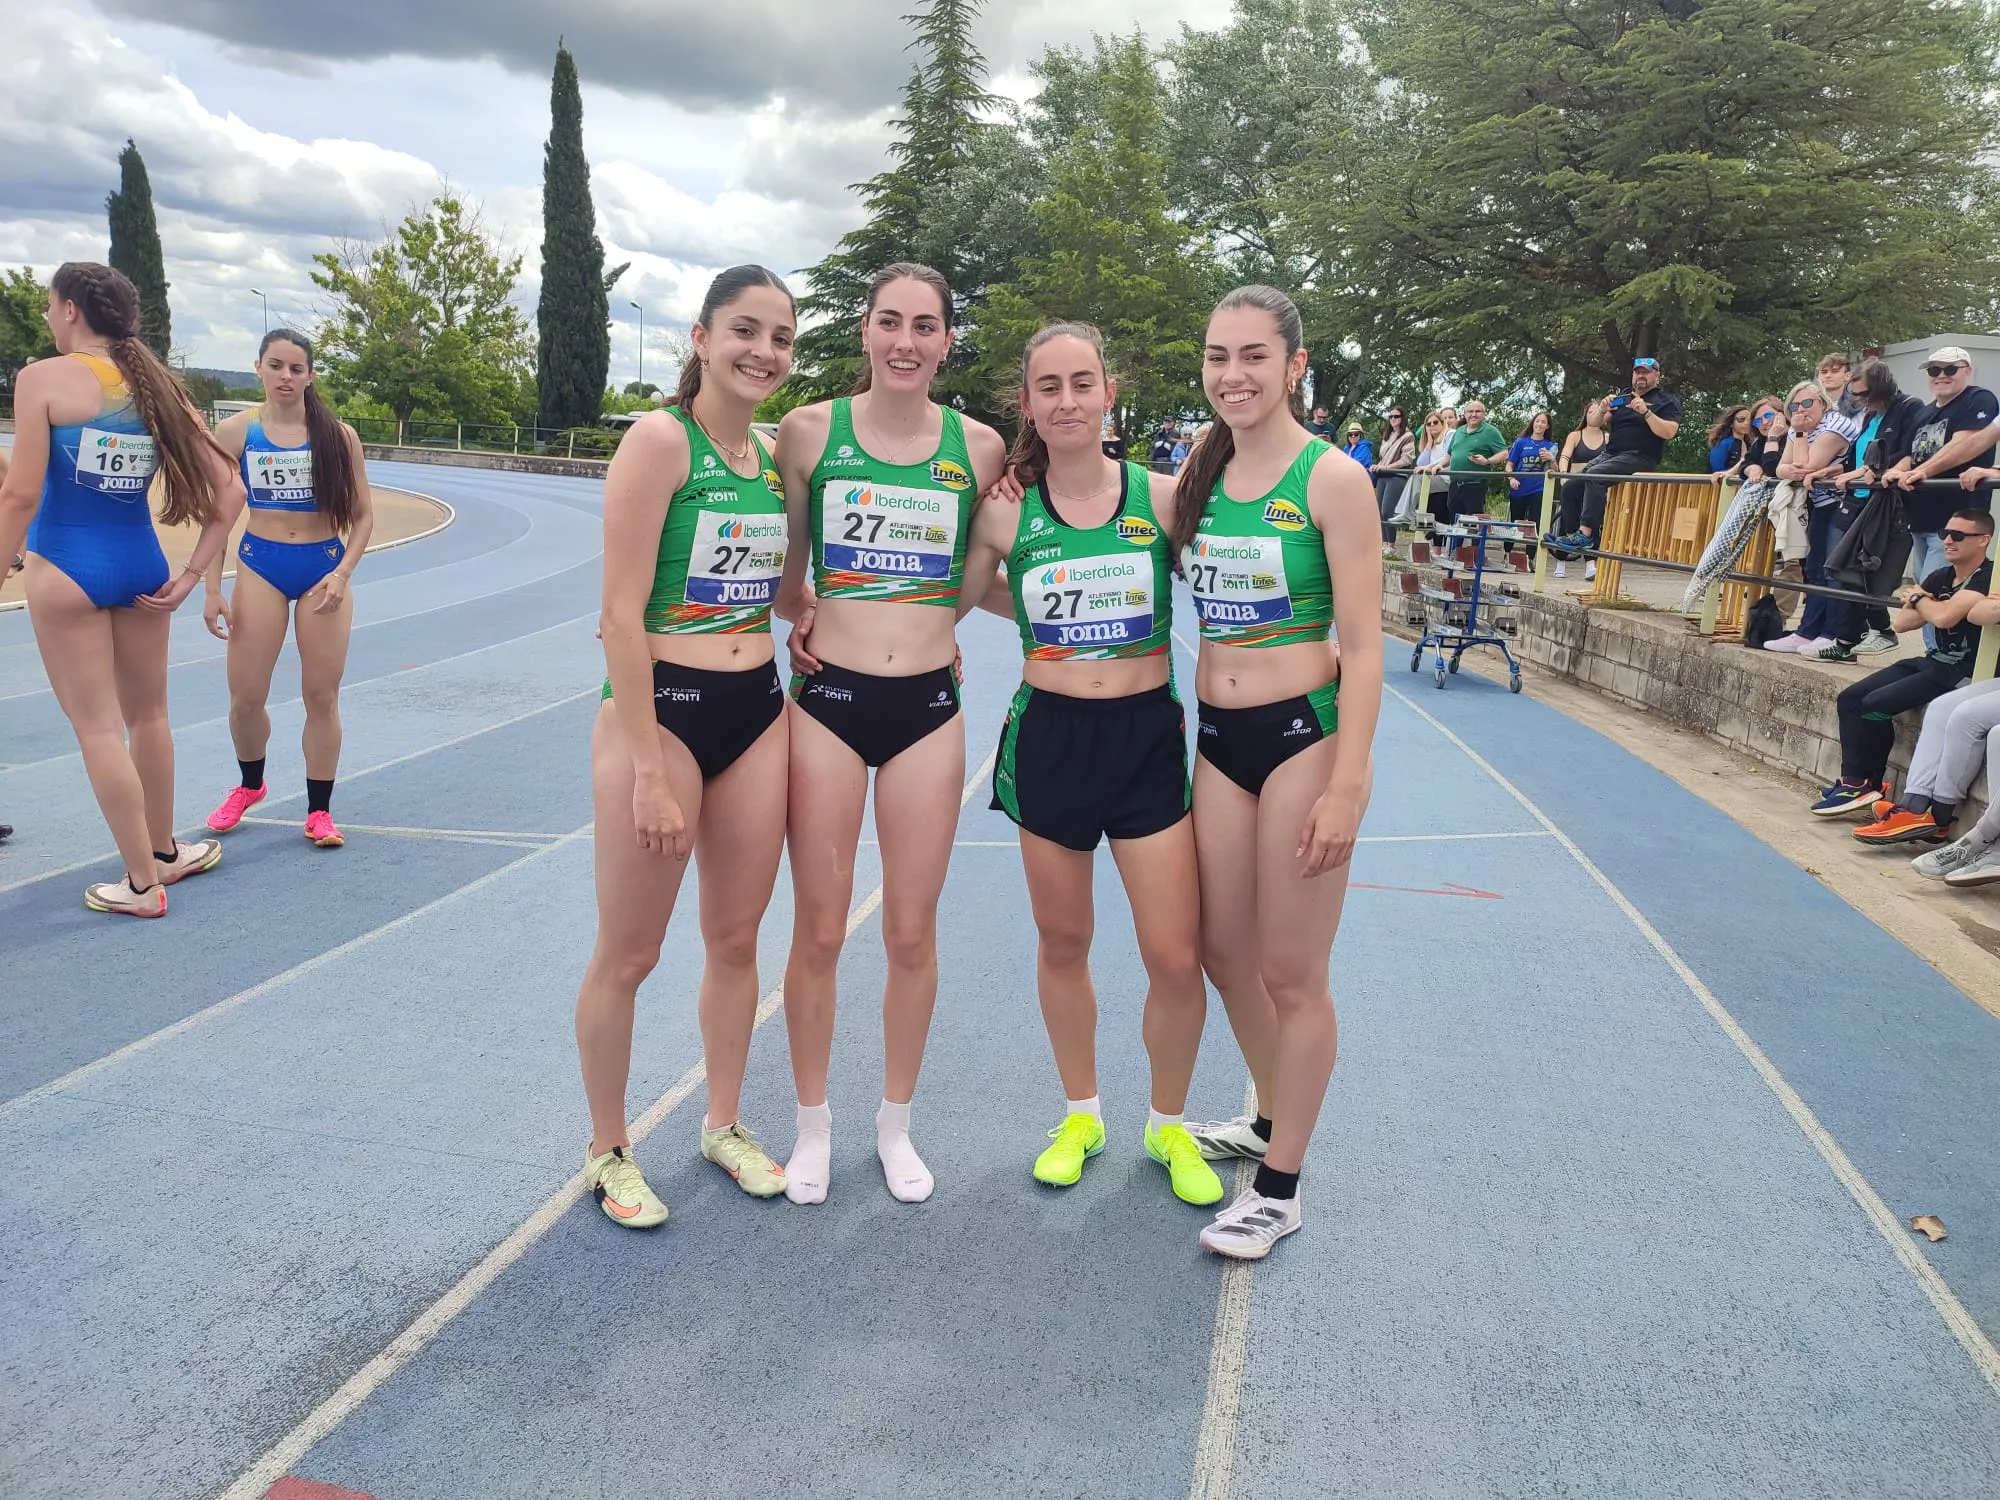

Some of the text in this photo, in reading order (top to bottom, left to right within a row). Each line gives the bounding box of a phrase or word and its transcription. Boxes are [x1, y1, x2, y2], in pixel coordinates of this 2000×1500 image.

[96, 452, 124, 472] 16
[823, 459, 866, 467] VIATOR
[261, 469, 286, 485] 15
[693, 469, 727, 480] VIATOR
[99, 477, 144, 489] Joma
[271, 488, 314, 500] Joma
[707, 491, 739, 502] ZOITI
[875, 493, 940, 513] Iberdrola
[743, 522, 782, 538] Iberdrola
[843, 512, 886, 543] 27
[889, 522, 923, 530] ATLETISMO
[888, 528, 922, 541] ZOITI
[1019, 527, 1055, 543] VIATOR
[1031, 542, 1062, 551] ATLETISMO
[1208, 542, 1261, 560] Iberdrola
[709, 546, 750, 575] 27
[851, 551, 922, 572] Joma
[1031, 547, 1061, 562] ZOITI
[749, 558, 772, 568] ZOITI
[1069, 564, 1135, 581] Iberdrola
[1191, 564, 1218, 594] 27
[717, 581, 770, 602] Joma
[1222, 579, 1249, 590] ZOITI
[1088, 591, 1122, 599] ATLETISMO
[1043, 589, 1083, 620] 27
[1088, 597, 1122, 609] ZOITI
[1202, 601, 1259, 621] Joma
[1058, 621, 1128, 644] Joma
[671, 693, 700, 702] ZOITI
[824, 690, 852, 702] ZOITI
[928, 700, 953, 708] VIATOR
[1283, 727, 1312, 737] VIATOR
